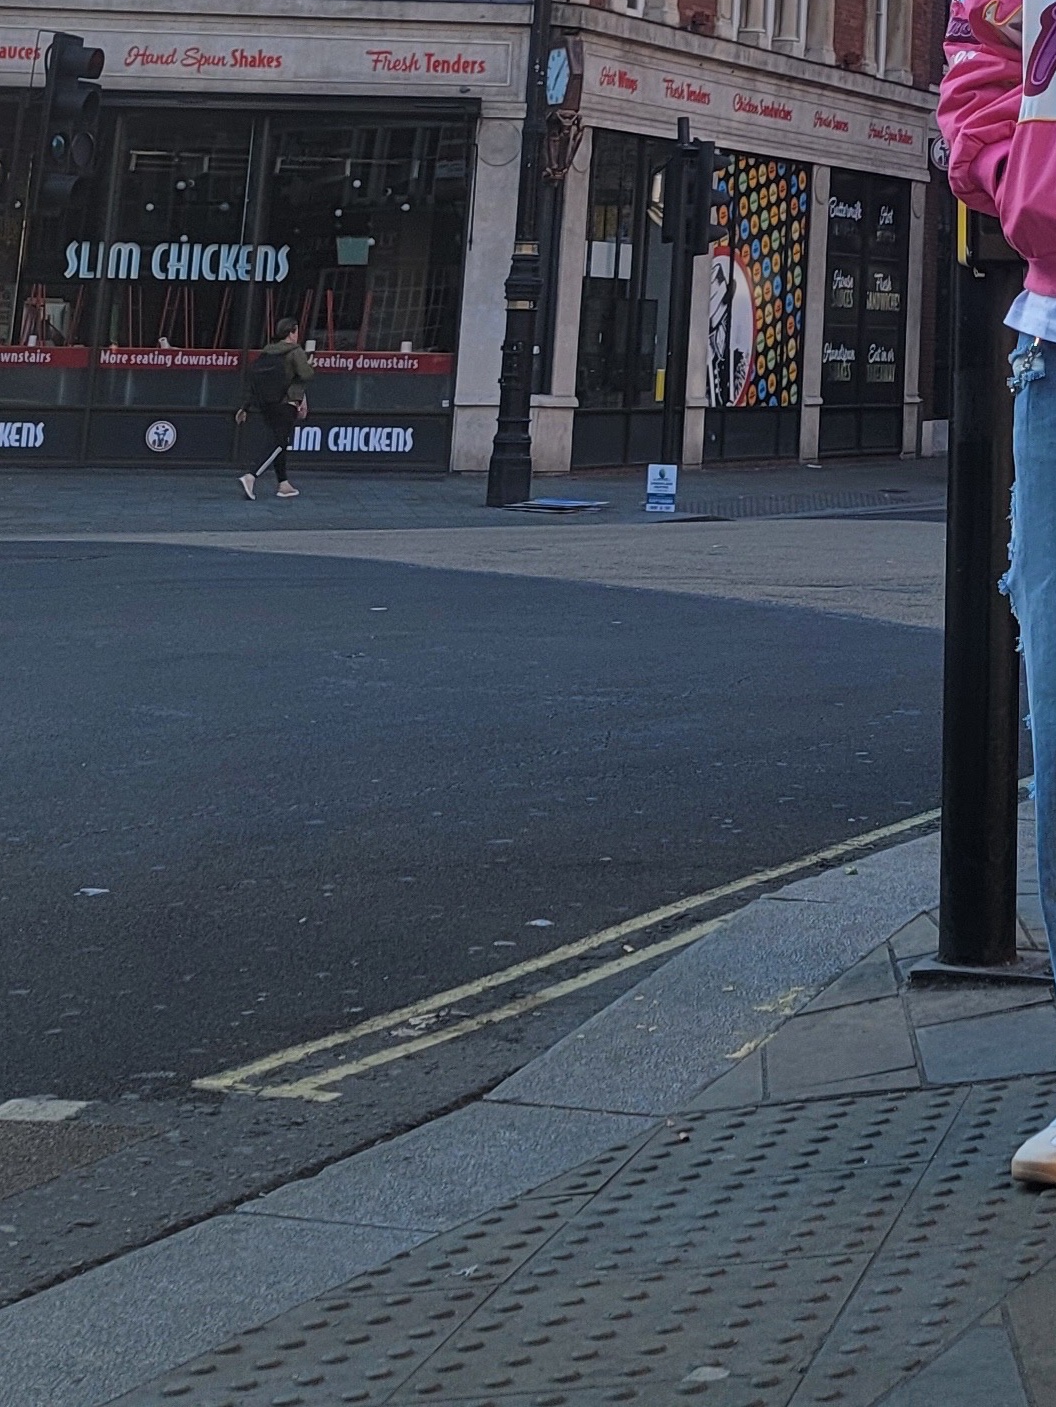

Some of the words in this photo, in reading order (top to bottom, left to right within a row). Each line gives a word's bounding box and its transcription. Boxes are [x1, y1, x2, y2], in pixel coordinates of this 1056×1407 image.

[124, 45, 177, 66] Hand
[180, 48, 229, 72] Spun
[230, 50, 282, 68] Shakes
[366, 50, 421, 72] Fresh
[424, 53, 486, 73] Tenders
[64, 240, 141, 280] SLIM
[151, 242, 290, 283] CHICKENS
[100, 352, 128, 364] More
[130, 353, 172, 367] seating
[174, 353, 238, 366] downstairs
[313, 355, 354, 370] seating
[356, 355, 419, 369] downstairs
[328, 427, 414, 452] CHICKENS
